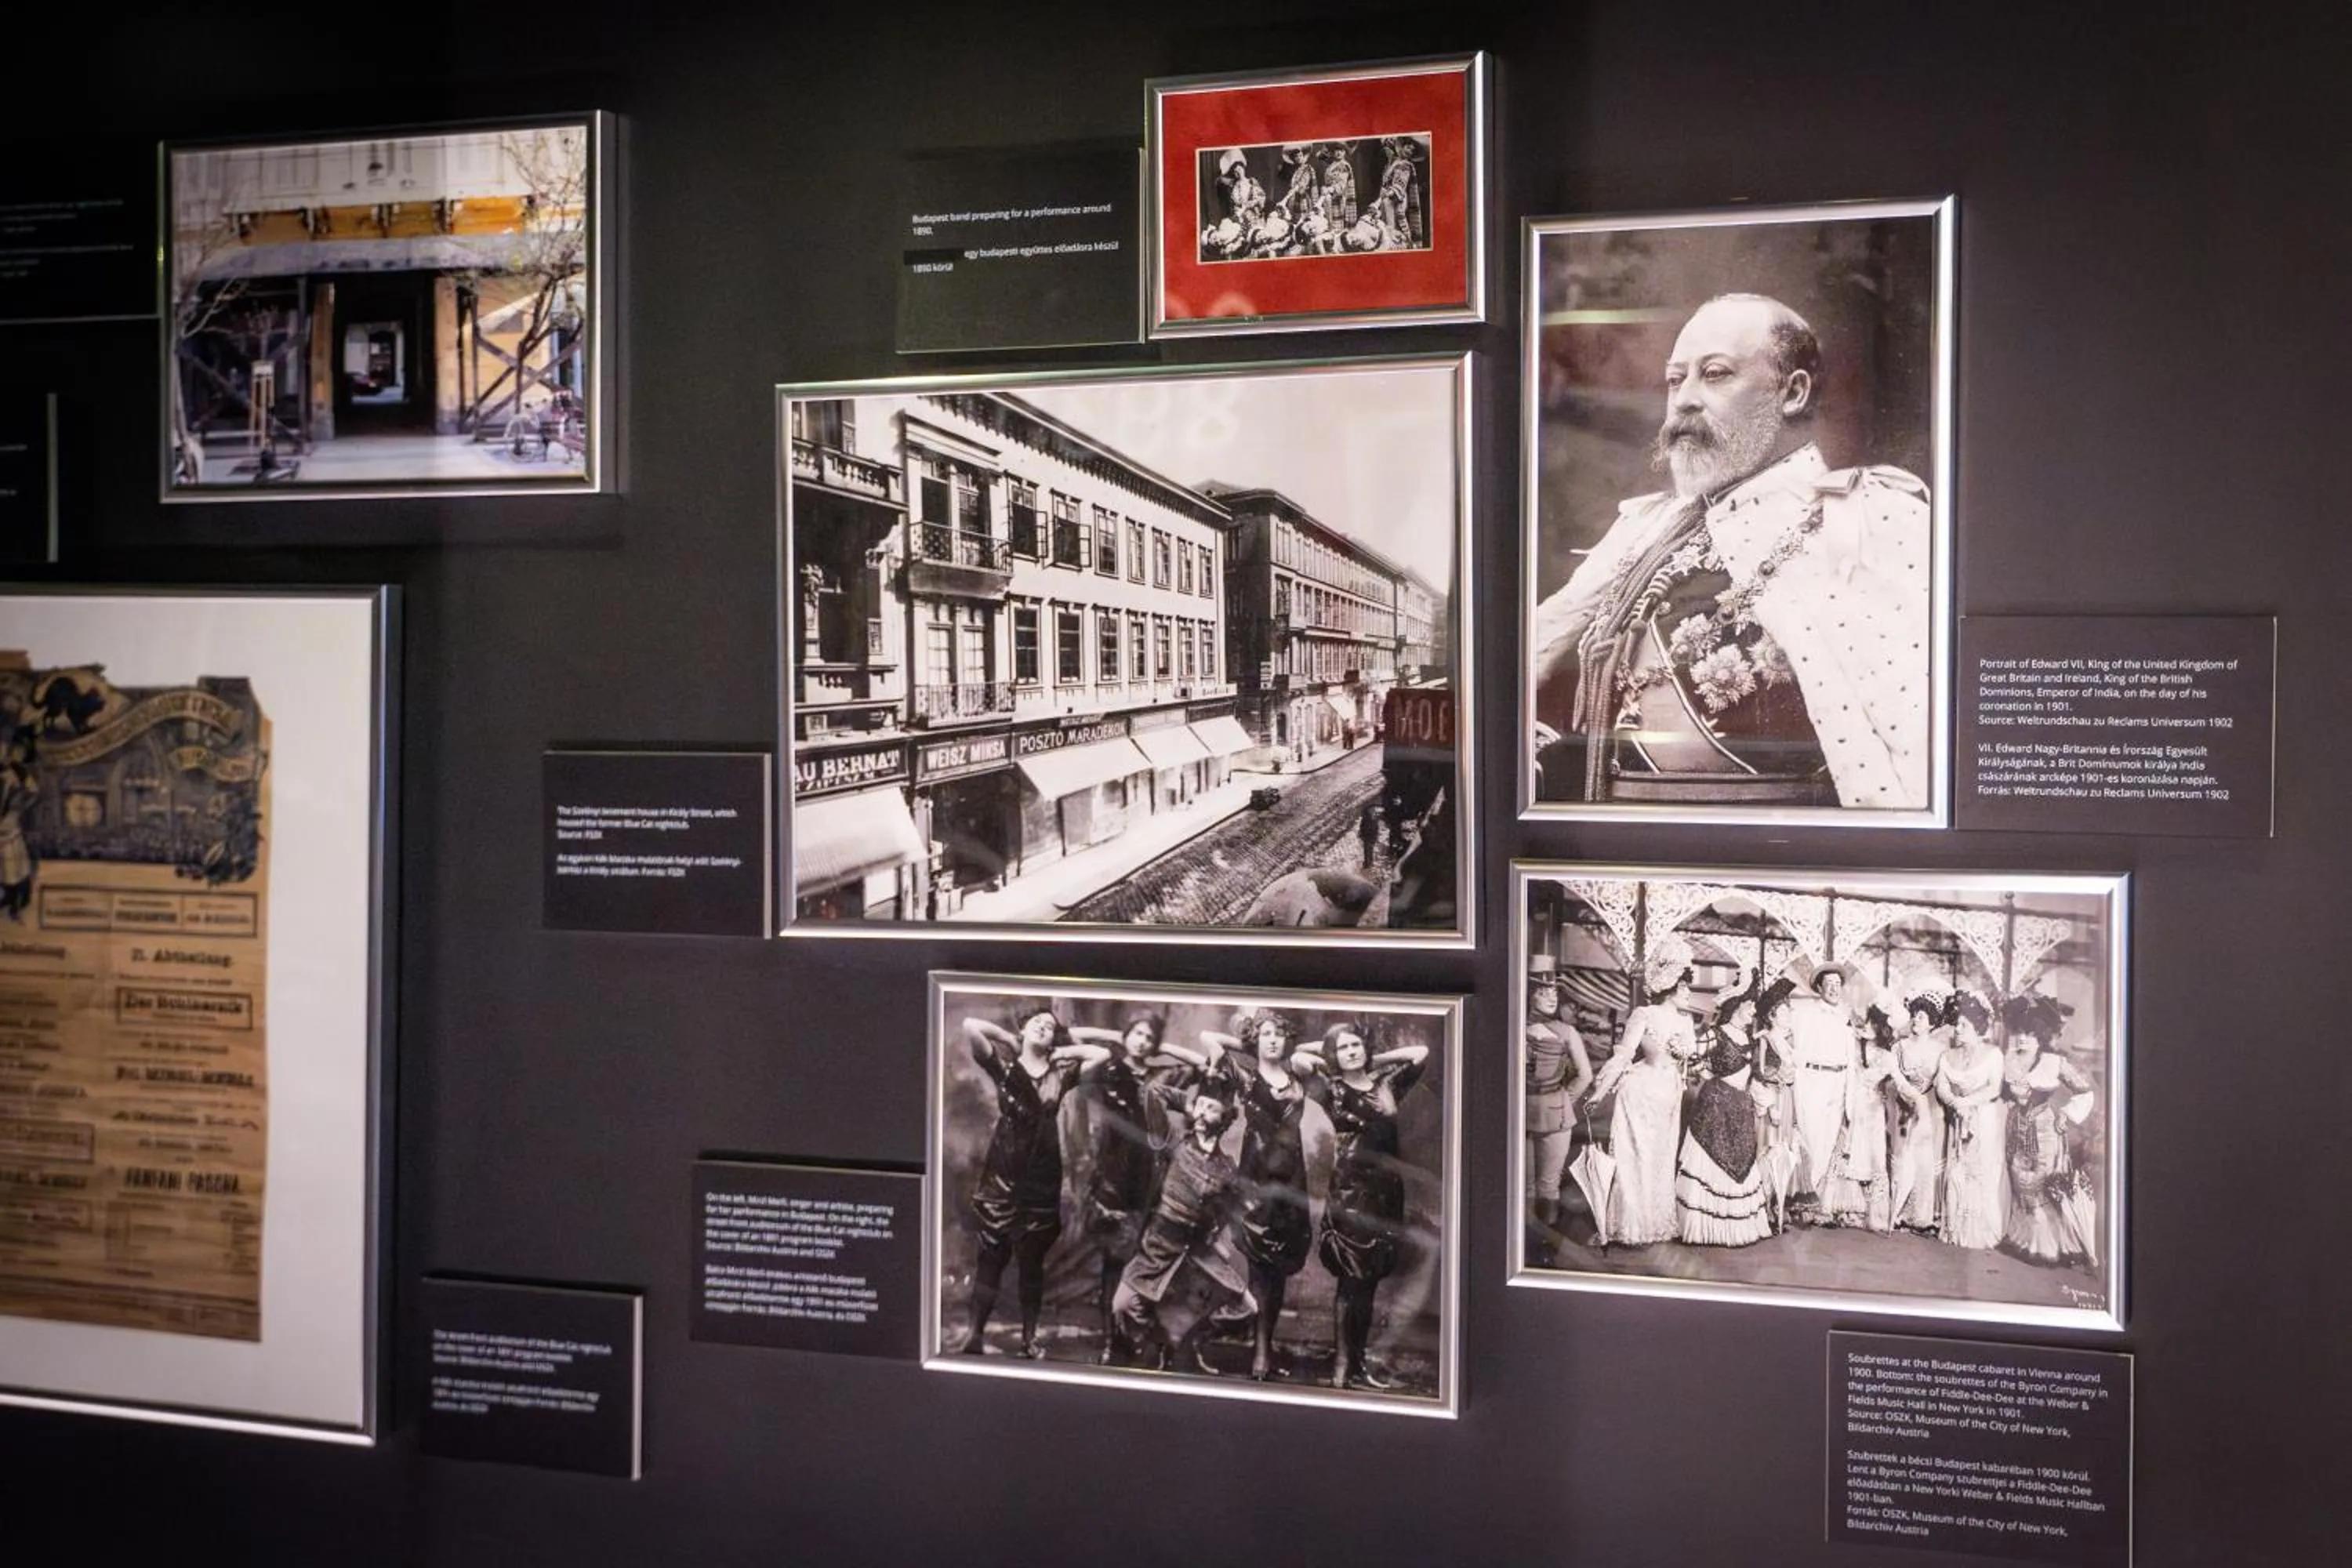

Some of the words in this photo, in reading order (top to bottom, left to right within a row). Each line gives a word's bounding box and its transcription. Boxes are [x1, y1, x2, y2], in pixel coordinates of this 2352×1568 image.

[912, 214, 949, 223] Budapest
[949, 212, 971, 221] band
[971, 211, 1010, 220] preparing
[1011, 209, 1022, 217] for
[1030, 207, 1080, 217] performance
[1082, 204, 1111, 213] around
[1980, 659, 2016, 668] Portrait
[2018, 659, 2029, 668] of
[2031, 659, 2068, 669] Edward
[2088, 659, 2110, 671] King
[2111, 659, 2122, 669] of
[2124, 660, 2140, 669] the
[2143, 660, 2176, 669] United
[2179, 660, 2224, 671] Kingdom
[2227, 659, 2238, 670] of
[1979, 673, 2006, 682] Great
[2009, 673, 2042, 682] Britain
[2042, 673, 2063, 682] and
[2064, 674, 2101, 683] Ireland,
[2103, 673, 2126, 685] King
[2128, 673, 2139, 683] of
[2140, 674, 2158, 683] the
[2160, 674, 2192, 683] British
[1979, 687, 2034, 697] Dominions,
[2036, 688, 2079, 698] Emperor
[2082, 688, 2092, 697] of
[2094, 688, 2122, 698] India,
[2140, 688, 2156, 698] the
[2158, 689, 2176, 699] day
[2179, 688, 2190, 698] of
[2034, 702, 2044, 710] in
[2046, 702, 2073, 710] 1901.
[1978, 715, 2015, 724] Source:
[2016, 716, 2091, 725] Weltrundschau
[2107, 717, 2149, 726] Reclams
[2151, 718, 2205, 727] Universum
[2209, 717, 2233, 728] 1902
[1995, 743, 2032, 753] Edward
[2034, 744, 2107, 755] Nagy-Britannia
[2109, 745, 2121, 754] és
[2058, 758, 2075, 768] Brit
[2038, 772, 2078, 783] arcképe
[2080, 773, 2118, 782] 1901-es
[2180, 776, 2217, 786] napján.
[2013, 786, 2088, 796] Weltrundschau
[2103, 788, 2145, 797] Reclams
[2147, 789, 2201, 798] Universum
[2205, 789, 2229, 800] 1902
[1848, 1353, 1900, 1366] Soubrettes
[1912, 1359, 1929, 1368] the
[1931, 1359, 1976, 1372] Budapest
[1978, 1365, 2015, 1375] cabaret
[2016, 1367, 2027, 1376] in
[2028, 1368, 2062, 1378] Vienna
[2064, 1373, 2100, 1381] around
[1849, 1367, 1874, 1377] 1900.
[1915, 1373, 1932, 1381] the
[1933, 1376, 1985, 1386] soubrettes
[1987, 1378, 1998, 1388] of
[2000, 1380, 2016, 1389] the
[2018, 1381, 2047, 1392] Byron
[2049, 1384, 2096, 1397] Company
[1847, 1381, 1864, 1391] the
[1865, 1384, 1927, 1396] performance
[1929, 1388, 1939, 1396] of
[1940, 1388, 2014, 1403] Fiddle-Dee-Dee
[2028, 1396, 2045, 1406] the
[2046, 1399, 2078, 1408] Weber
[1847, 1395, 1875, 1405] Fields
[1876, 1397, 1904, 1407] Music
[1907, 1400, 1926, 1409] Hall
[1939, 1403, 1961, 1412] New
[1962, 1404, 1984, 1414] York
[1998, 1407, 2024, 1417] 1901.
[1847, 1409, 1882, 1419] Source:
[1915, 1414, 1957, 1425] Museum
[1958, 1418, 1969, 1427] of
[1971, 1419, 1987, 1428] the
[1989, 1421, 2008, 1432] City
[2009, 1423, 2020, 1432] of
[2022, 1424, 2044, 1433] New
[2045, 1426, 2070, 1438] York,
[1847, 1423, 1894, 1434] Bildarchiv
[1895, 1427, 1929, 1437] Austria
[1934, 1457, 1980, 1470] Budapest
[2037, 1468, 2060, 1478] 1900
[1846, 1465, 1868, 1474] Lent
[1878, 1467, 1907, 1478] Byron
[1908, 1469, 1954, 1483] Company
[2017, 1480, 2092, 1495] Fiddle-Dee-Dee
[1911, 1483, 1933, 1494] New
[1961, 1489, 1993, 1499] Weber
[2005, 1493, 2034, 1504] Fields
[2035, 1496, 2064, 1507] Music
[1846, 1519, 1893, 1530] Bildarchiv
[1894, 1524, 1929, 1535] Austria
[1912, 1512, 1954, 1523] Museum
[1955, 1515, 1966, 1525] of
[1968, 1518, 1984, 1526] the
[1986, 1519, 2005, 1530] City
[2006, 1521, 2017, 1530] of
[2019, 1523, 2041, 1533] New
[2042, 1526, 2067, 1537] York,
